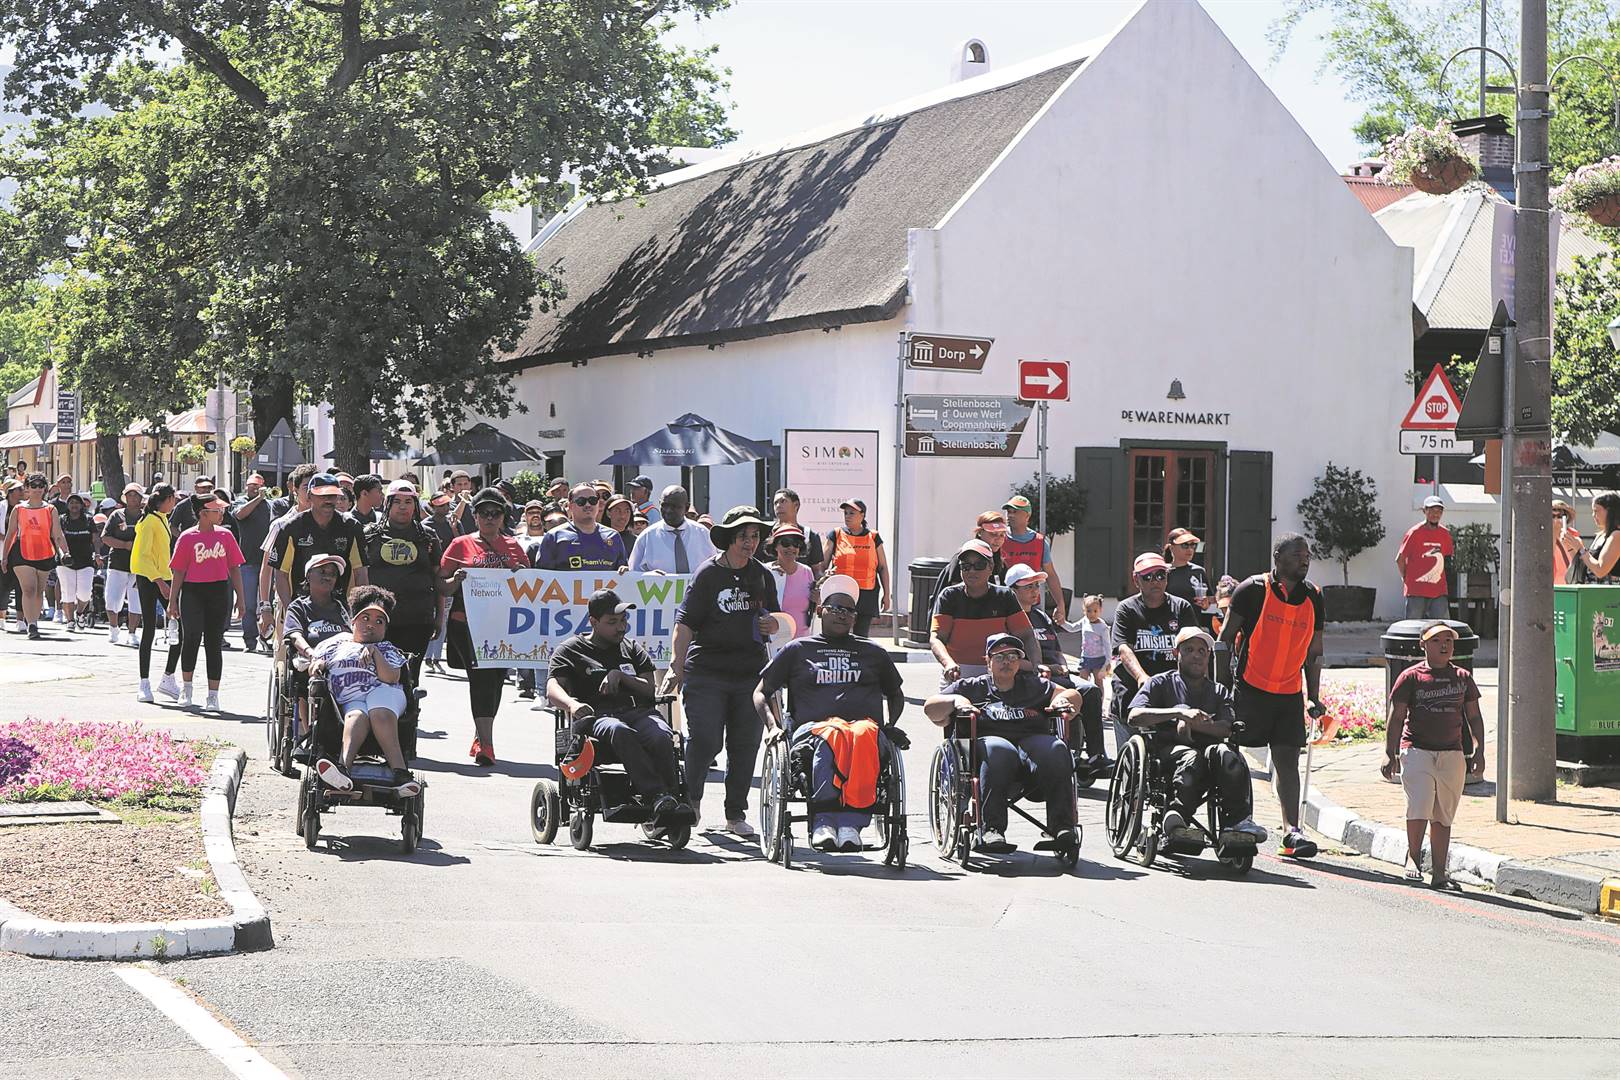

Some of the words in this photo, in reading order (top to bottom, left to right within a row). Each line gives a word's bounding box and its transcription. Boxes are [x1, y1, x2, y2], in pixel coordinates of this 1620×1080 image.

[938, 347, 966, 363] Dorp
[942, 398, 1001, 408] Stellenbosch
[1426, 401, 1447, 413] STOP
[952, 409, 978, 418] Ouwe
[980, 409, 1003, 418] Werf
[1121, 410, 1133, 422] DE
[1134, 410, 1231, 425] WARENMARKT
[942, 440, 1000, 449] Stellenbosch
[1420, 435, 1437, 448] 75
[1440, 438, 1454, 448] m
[470, 588, 503, 597] Network
[636, 577, 688, 606] WI
[725, 601, 750, 611] WORLD
[316, 625, 342, 633] WORLD
[828, 657, 850, 670] DIS
[816, 670, 861, 684] ABILITY
[995, 708, 1025, 719] WORLD
[1598, 721, 1614, 729] BLUE
